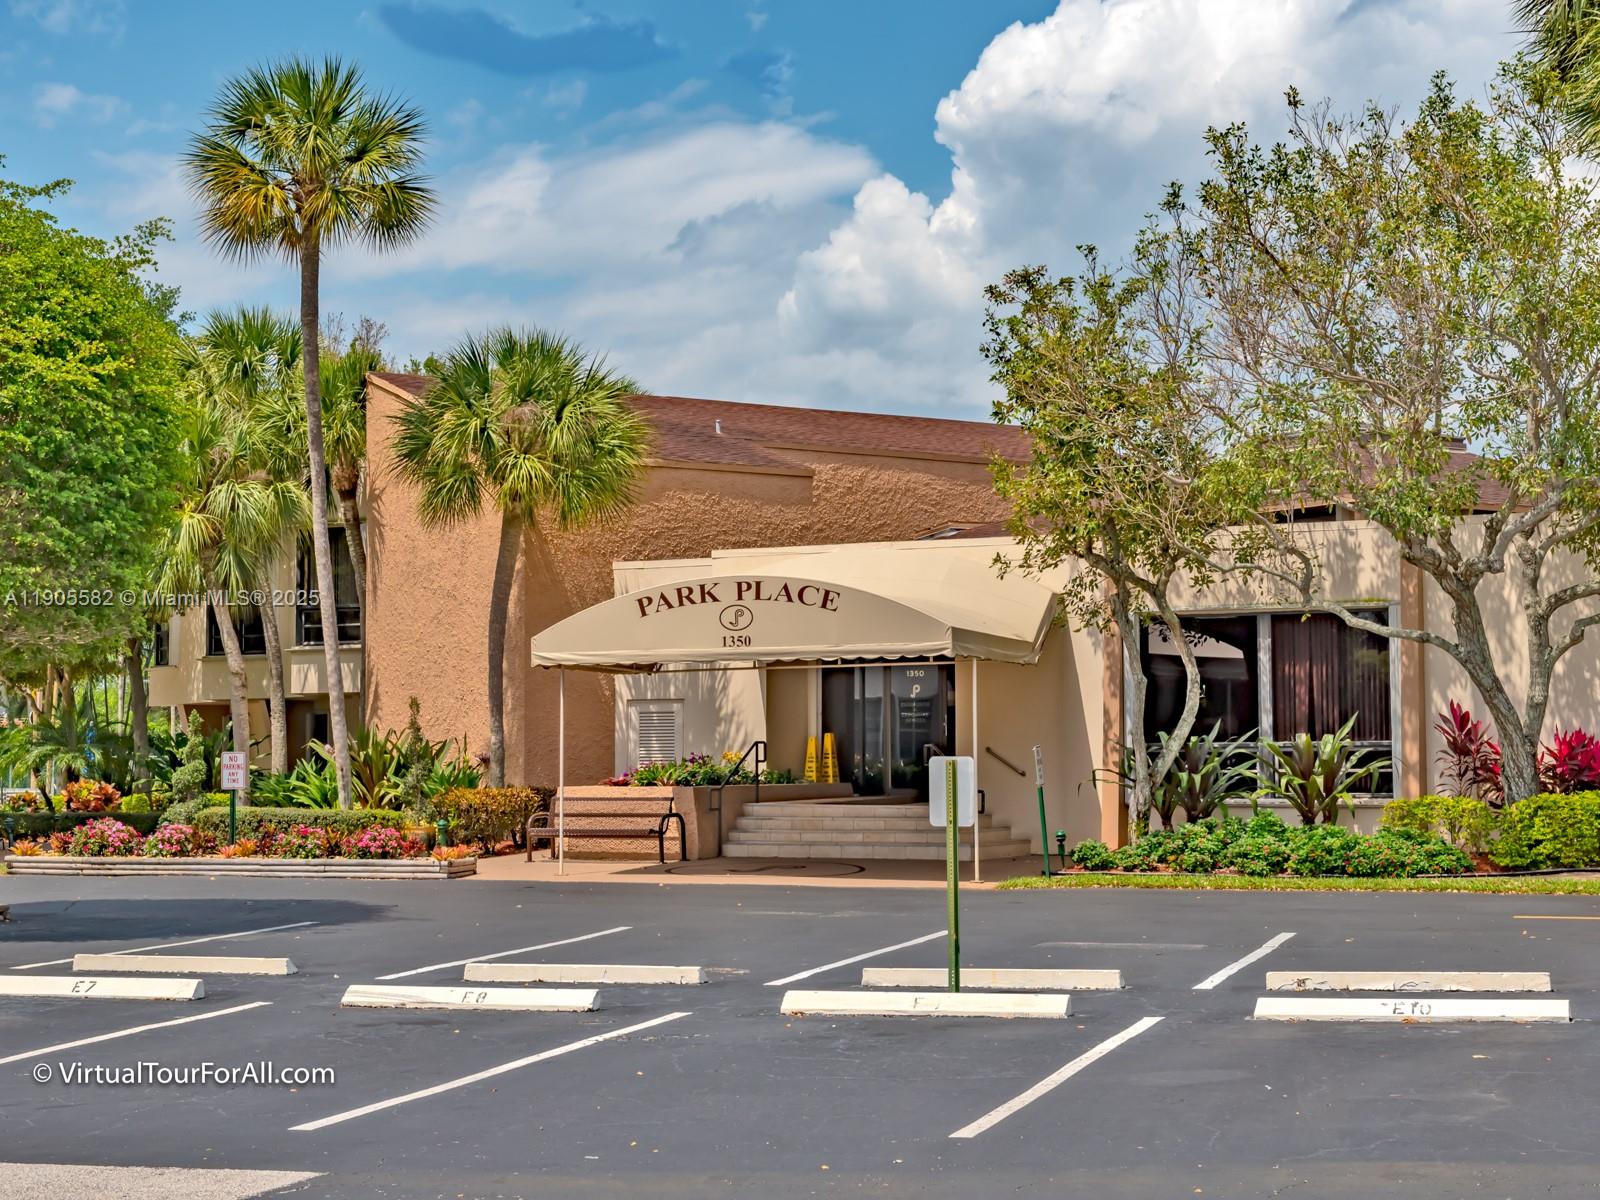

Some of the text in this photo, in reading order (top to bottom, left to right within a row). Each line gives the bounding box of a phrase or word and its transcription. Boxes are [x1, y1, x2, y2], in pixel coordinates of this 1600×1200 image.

[635, 580, 841, 618] PARK PLACE
[721, 635, 752, 648] 1350
[71, 980, 97, 993] E7
